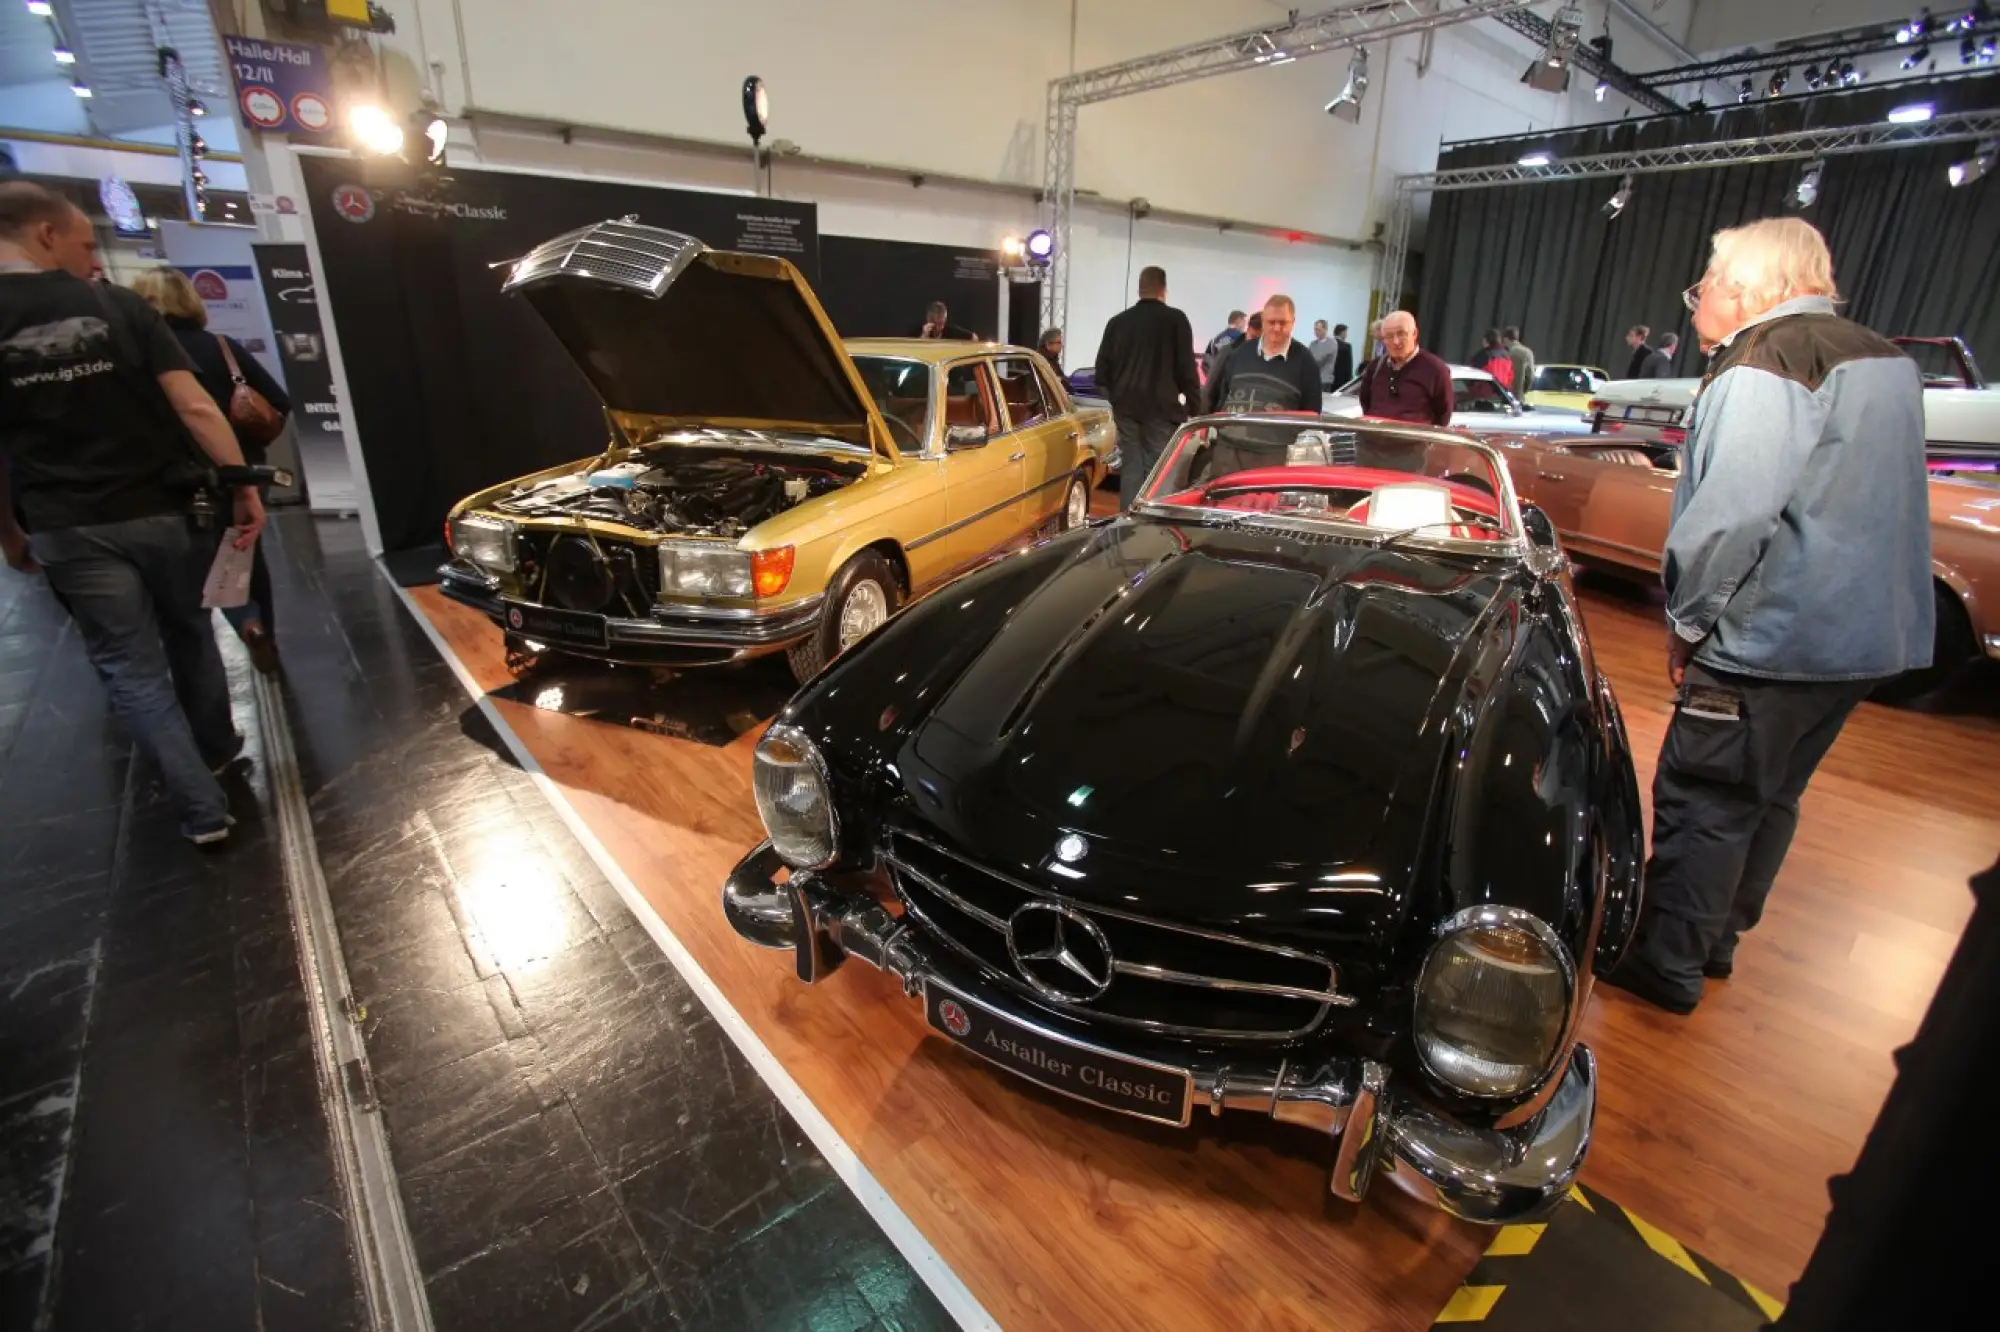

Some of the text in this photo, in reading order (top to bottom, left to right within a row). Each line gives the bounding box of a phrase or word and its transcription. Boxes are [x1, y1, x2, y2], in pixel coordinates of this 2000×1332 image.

[453, 202, 508, 221] Classic
[271, 267, 304, 279] Klima
[983, 1028, 1173, 1105] Astaller Classic
